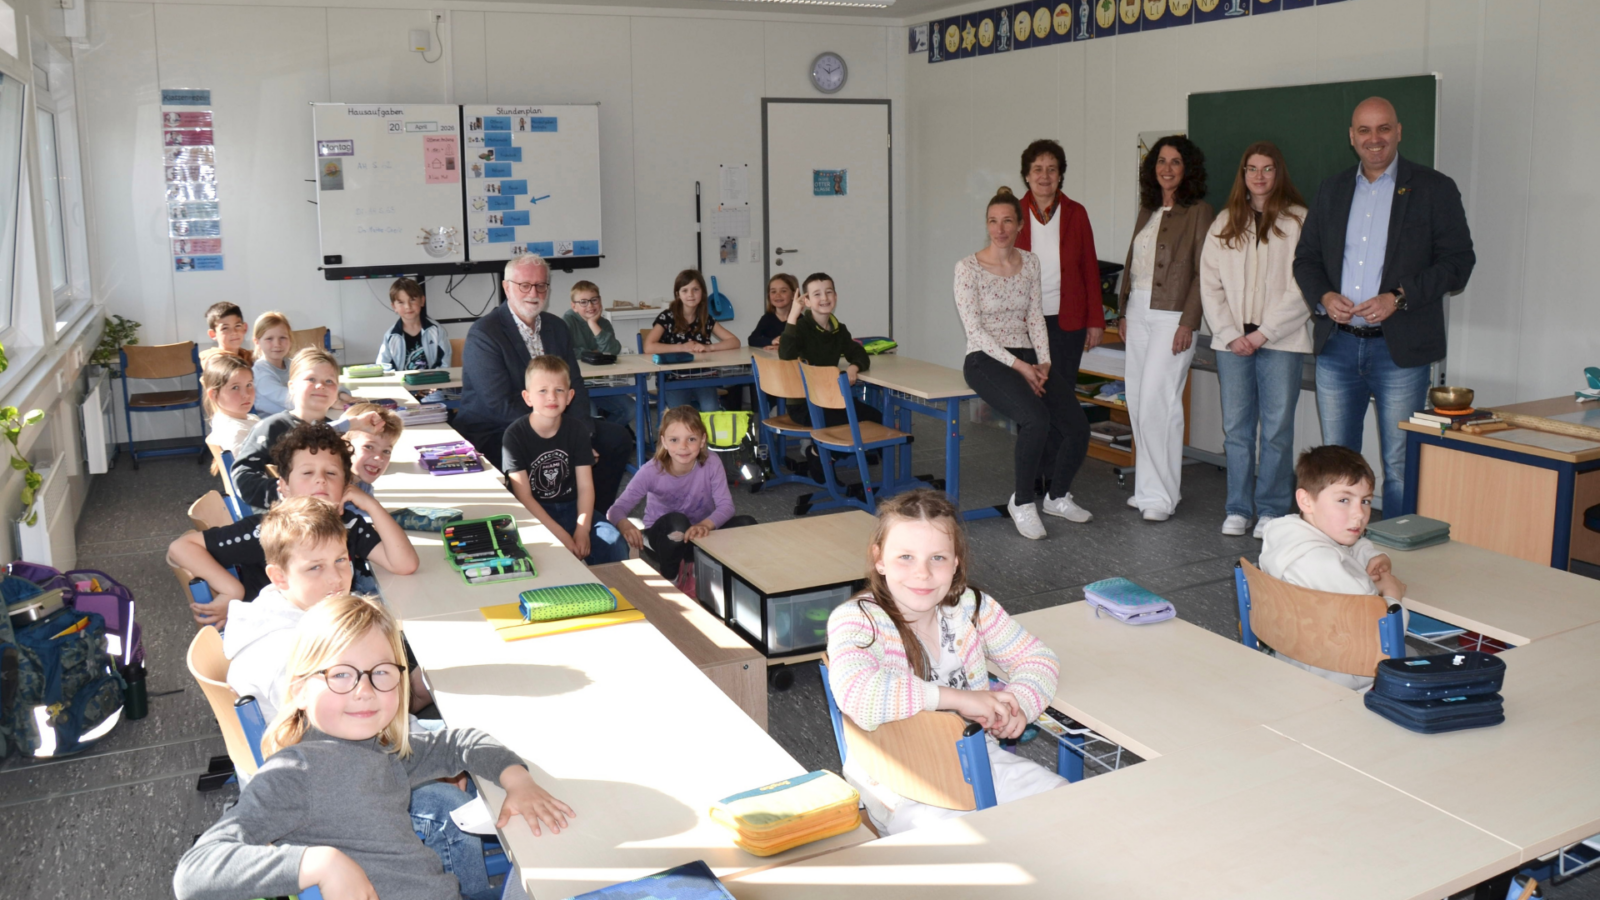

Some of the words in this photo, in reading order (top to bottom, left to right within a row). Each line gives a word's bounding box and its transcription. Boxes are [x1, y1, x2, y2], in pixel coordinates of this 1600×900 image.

[348, 108, 404, 118] Hausaufgaben
[496, 107, 542, 117] Stundenplan
[389, 123, 403, 132] 20.
[321, 143, 352, 153] Montag
